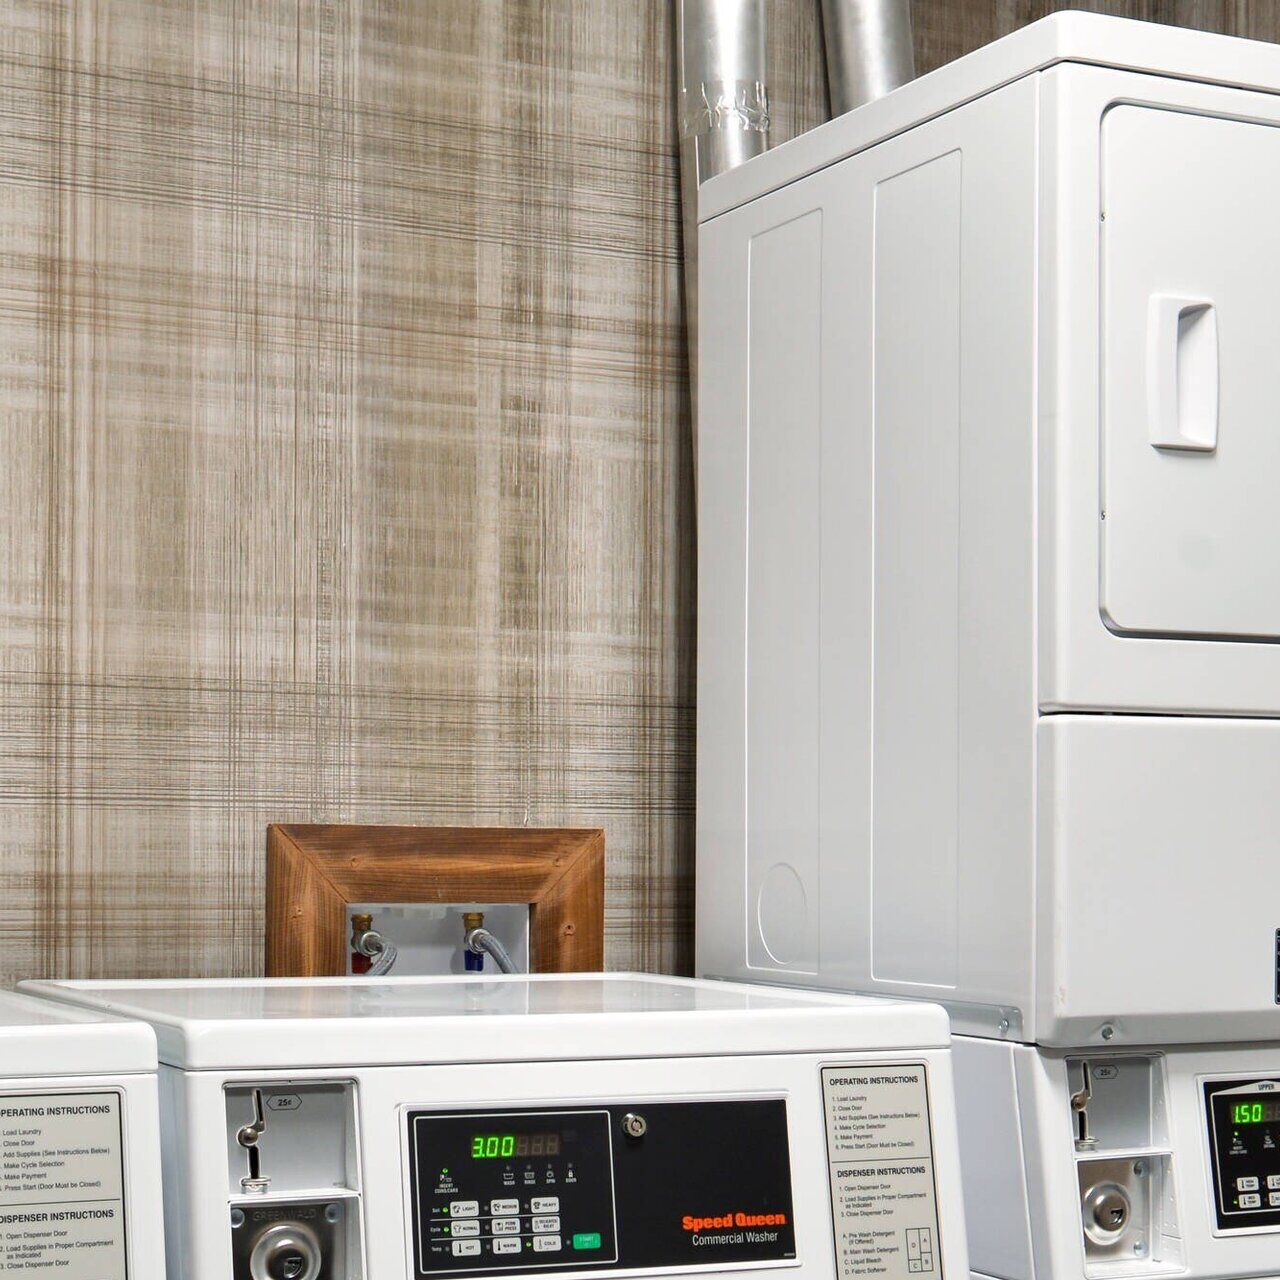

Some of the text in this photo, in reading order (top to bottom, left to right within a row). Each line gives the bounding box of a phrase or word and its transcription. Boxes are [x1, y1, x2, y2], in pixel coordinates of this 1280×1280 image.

[47, 1106, 110, 1115] INSTRUCTIONS
[91, 1148, 110, 1156] Below)
[473, 1137, 515, 1158] 3.00
[21, 1161, 37, 1169] Cycle
[838, 1167, 925, 1177] DISPENSER INSTRUCTIONS
[51, 1210, 114, 1220] INSTRUCTIONS
[682, 1213, 786, 1232] Speed Queen
[6, 1233, 22, 1241] Open
[24, 1232, 52, 1240] Dispenser
[692, 1231, 779, 1246] Commercial Washer
[76, 1240, 114, 1248] Compartment
[25, 1261, 54, 1269] Dispenser
